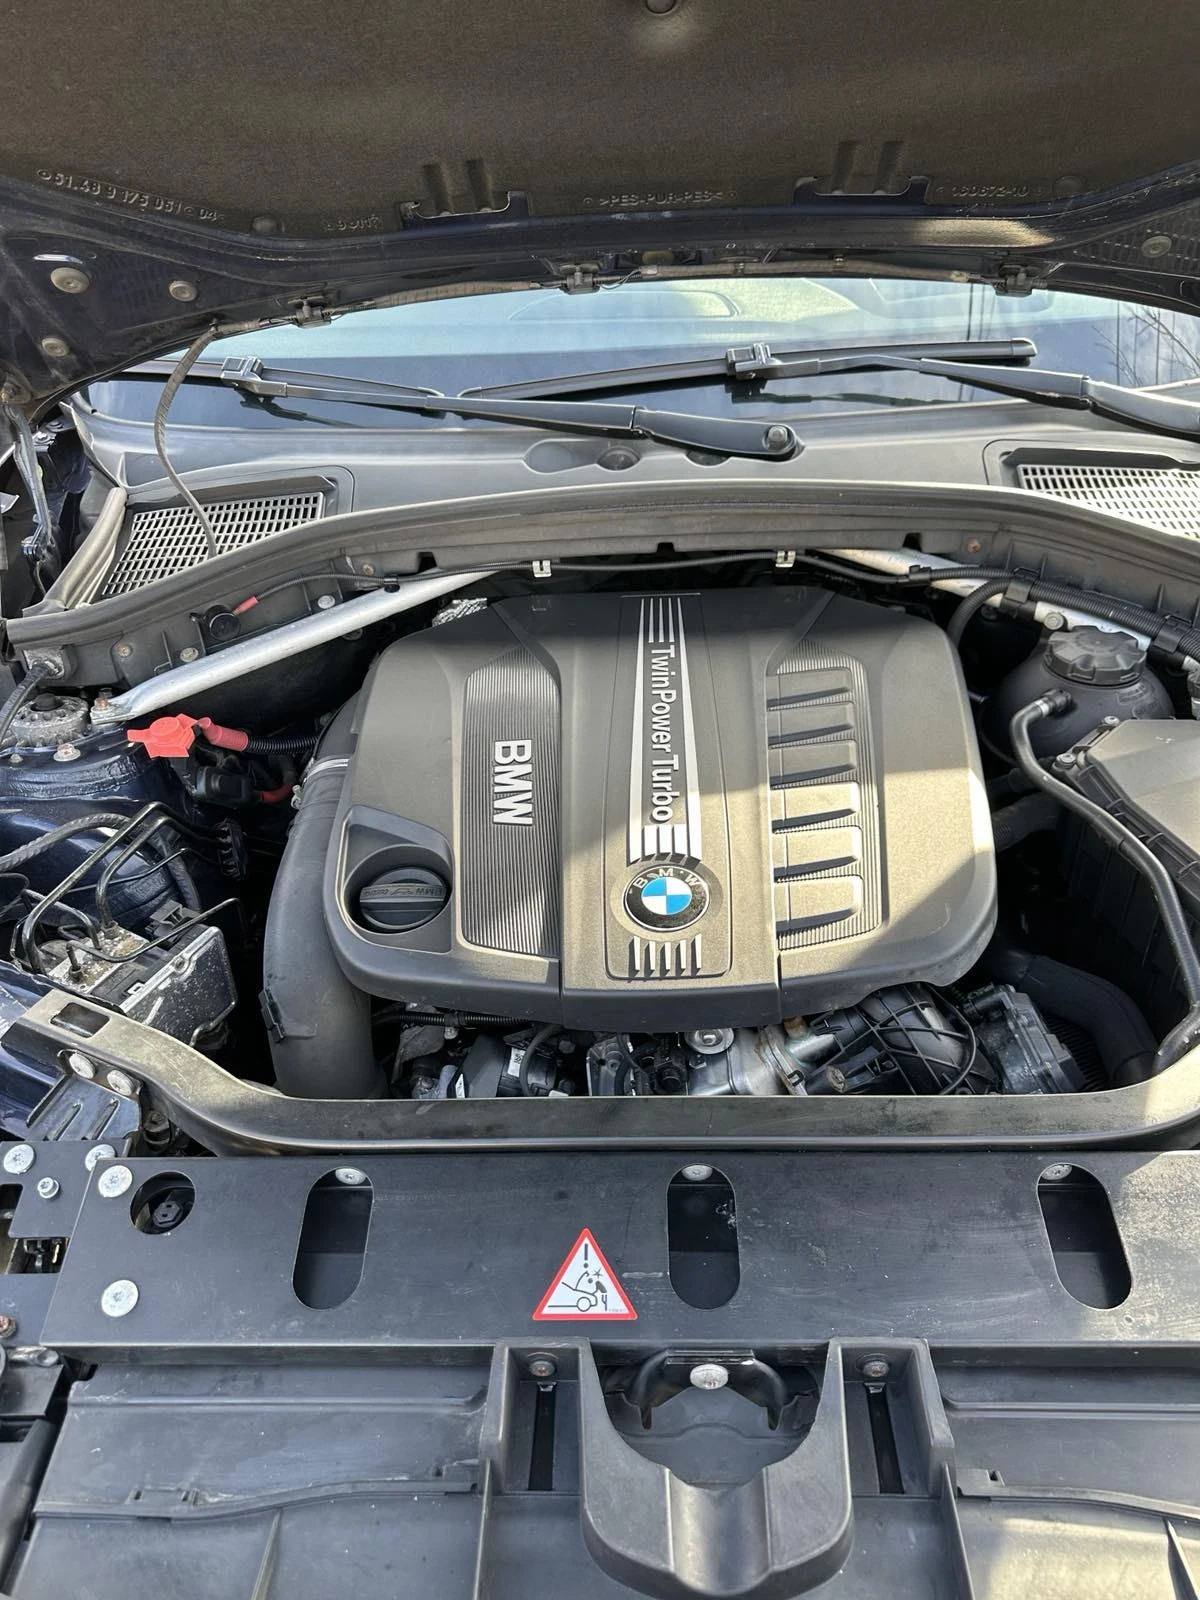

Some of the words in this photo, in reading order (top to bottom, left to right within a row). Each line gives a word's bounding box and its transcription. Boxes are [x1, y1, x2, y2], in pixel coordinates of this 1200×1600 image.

[650, 645, 676, 752] TwinPower
[494, 740, 532, 825] BMW
[651, 754, 680, 823] Turbo
[633, 868, 701, 889] BMW
